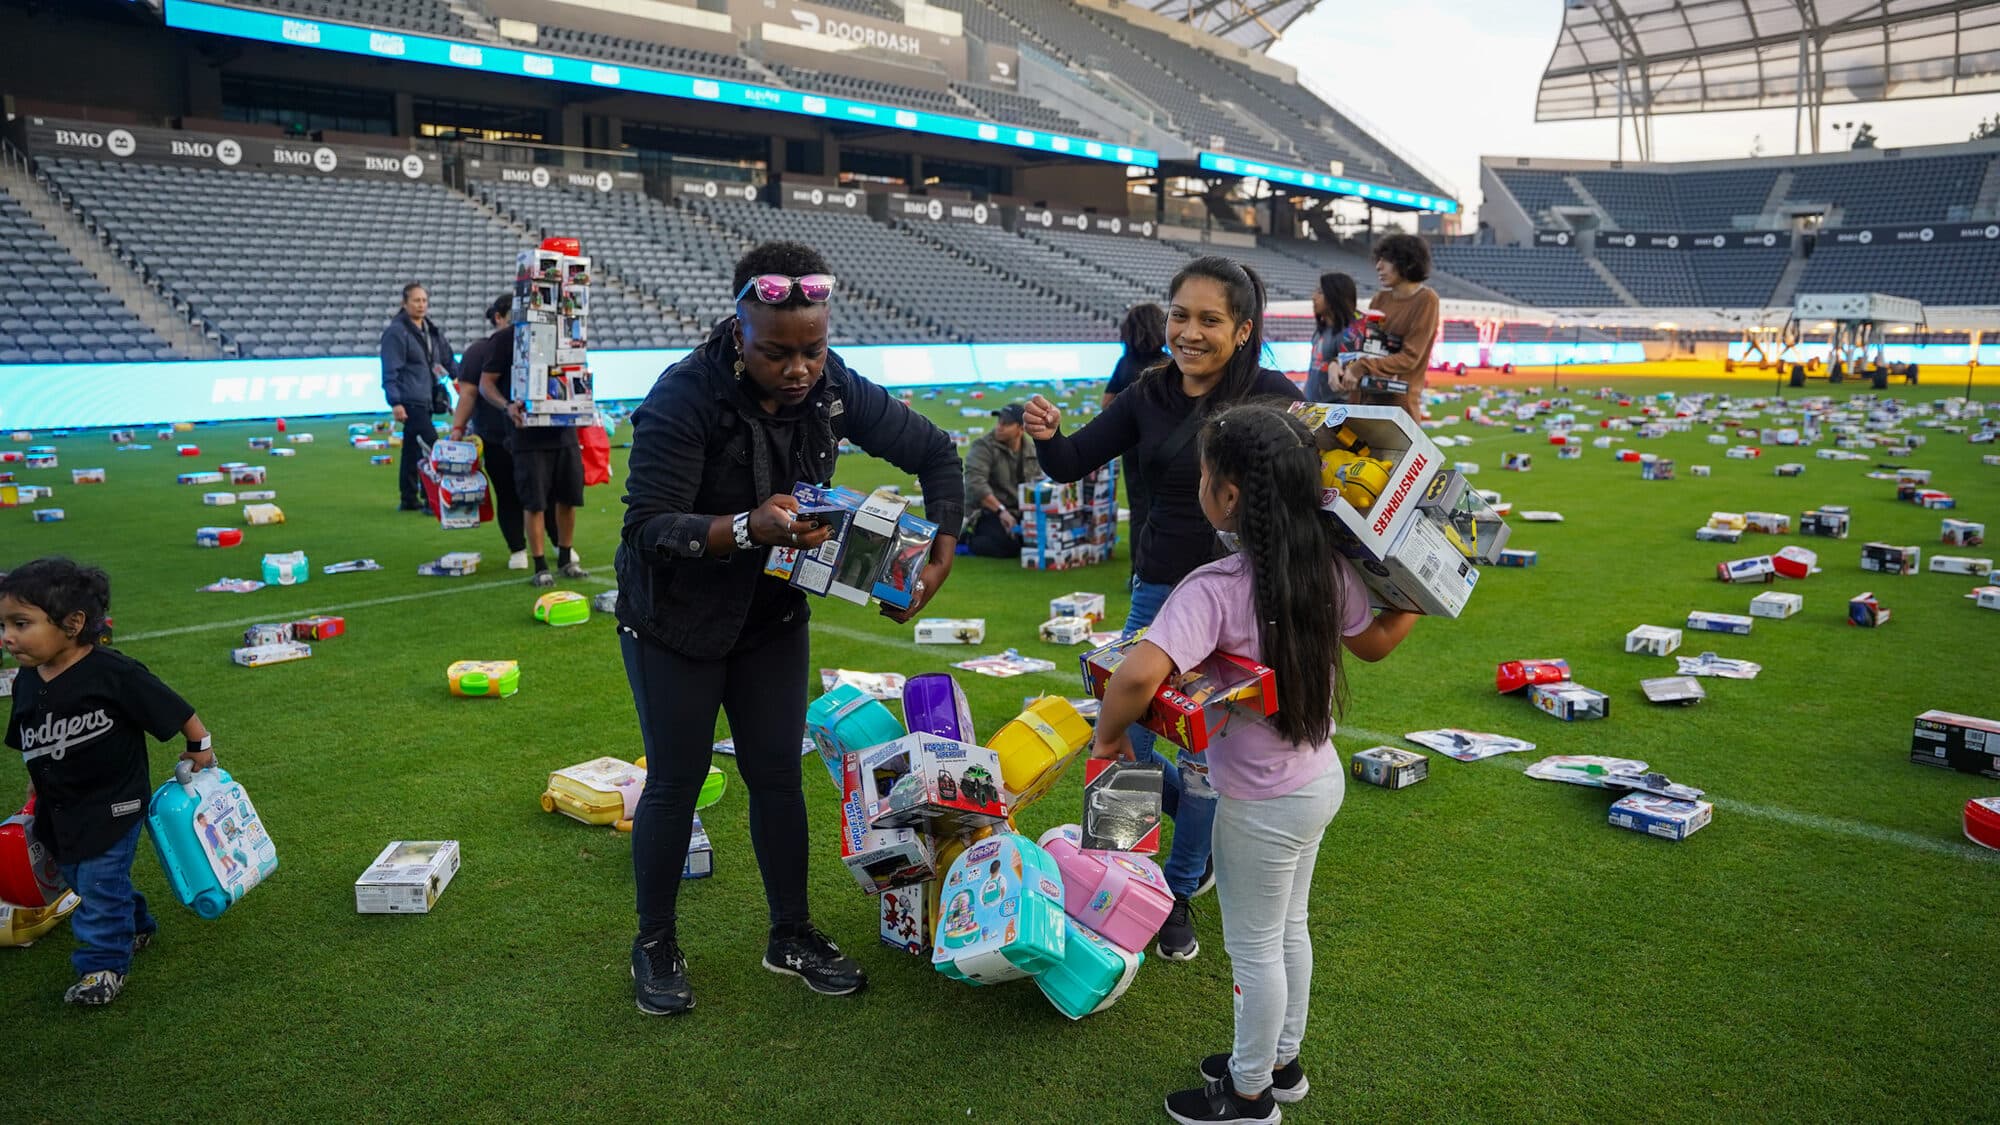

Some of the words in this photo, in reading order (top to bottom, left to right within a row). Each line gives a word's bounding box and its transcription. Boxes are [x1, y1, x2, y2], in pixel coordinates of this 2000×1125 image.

[825, 19, 920, 55] DOORDASH
[55, 130, 103, 148] BMO
[170, 141, 213, 157] BMO
[273, 149, 311, 165] BMO
[365, 157, 400, 172] BMO
[502, 169, 530, 182] BMO
[568, 174, 595, 187] BMO
[212, 372, 374, 403] RITFIT
[1373, 453, 1428, 536] TRANSFORMERS
[851, 791, 865, 819] RAPTOR
[851, 827, 863, 851] FORD
